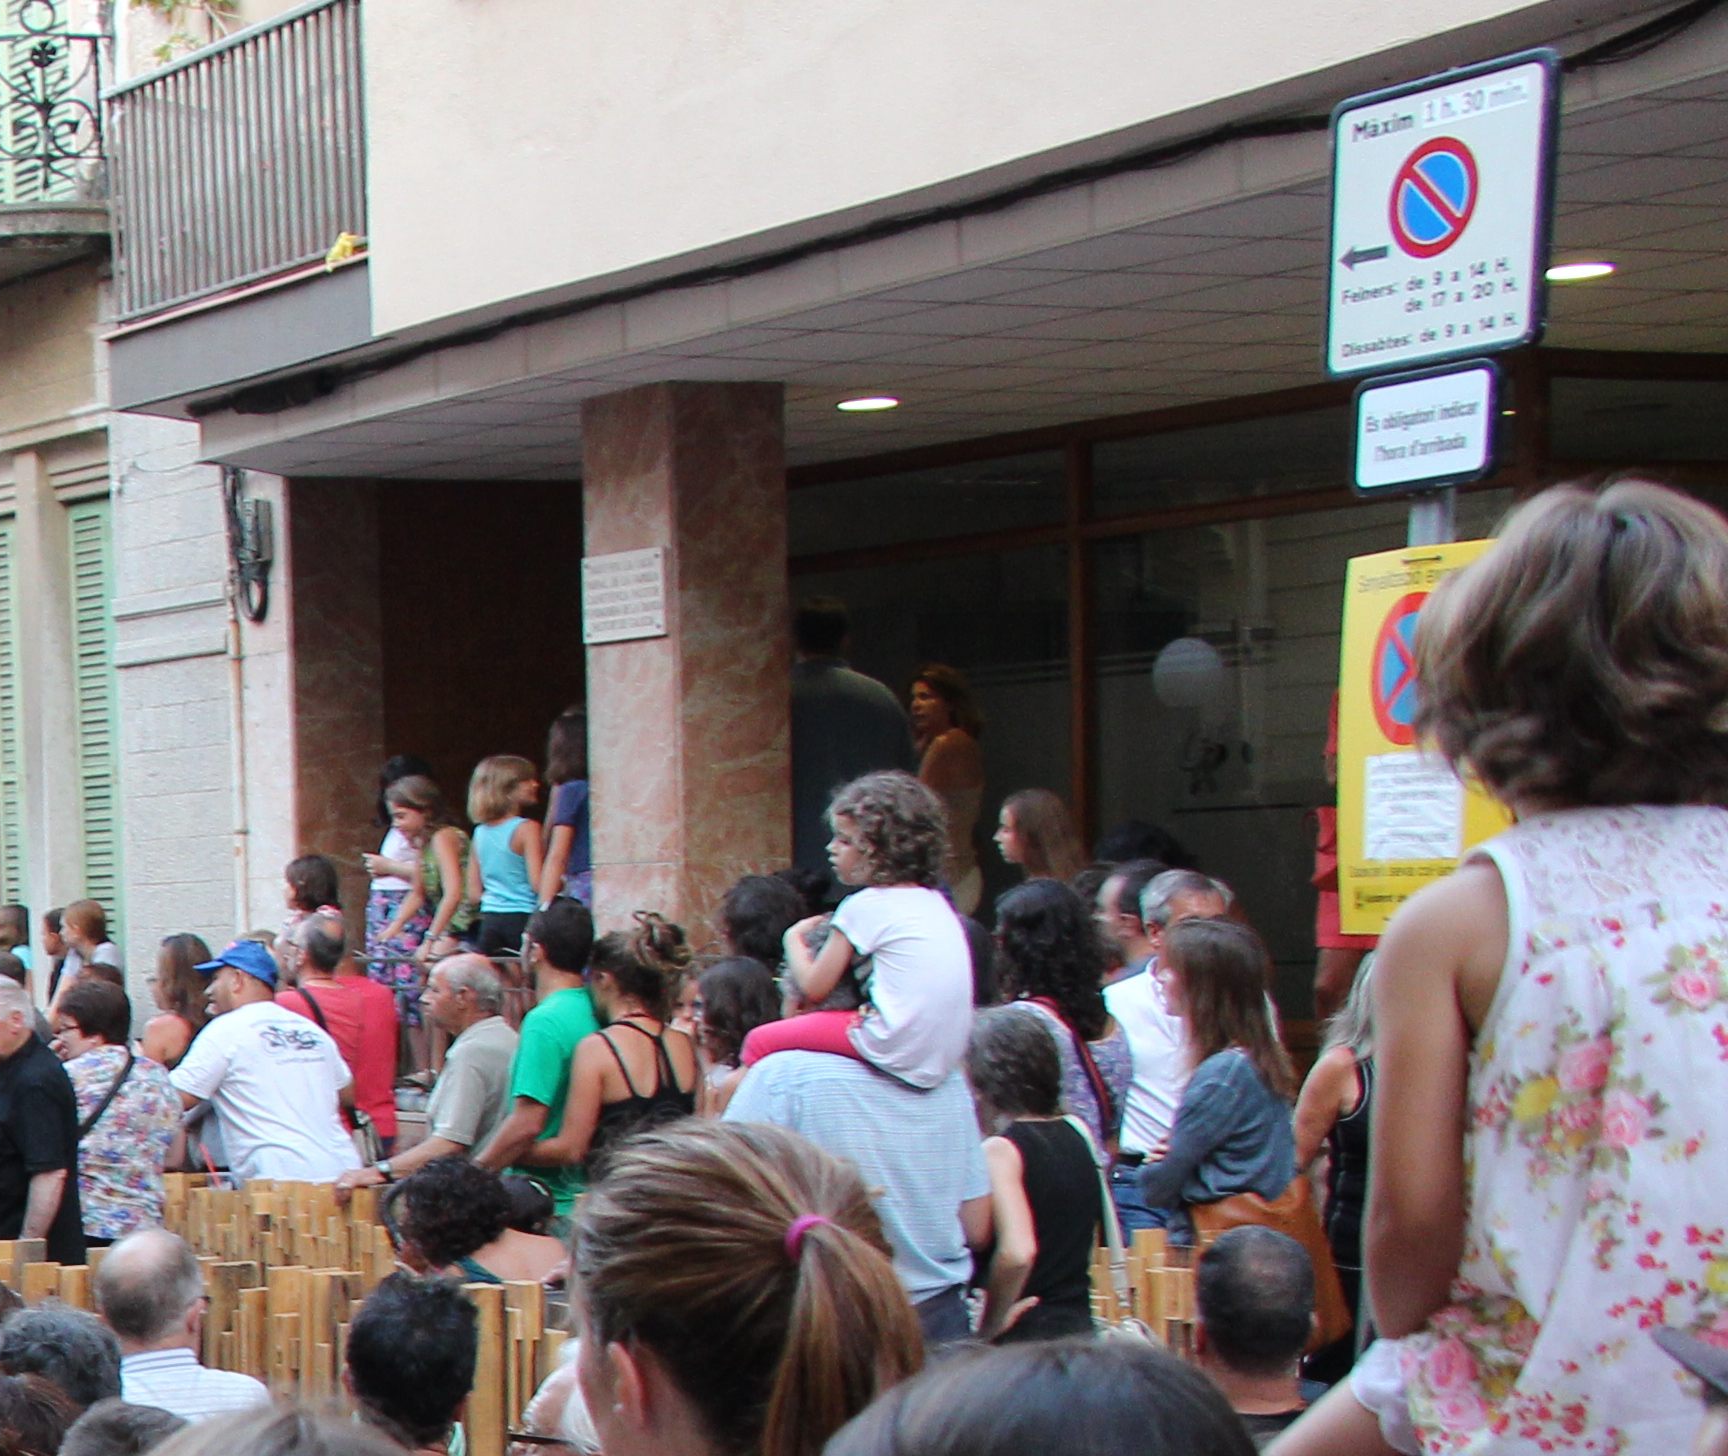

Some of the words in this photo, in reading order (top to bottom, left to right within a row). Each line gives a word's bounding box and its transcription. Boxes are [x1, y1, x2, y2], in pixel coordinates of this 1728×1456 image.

[1461, 89, 1488, 113] 30
[1406, 276, 1424, 292] de
[1432, 270, 1443, 286] 9
[1450, 271, 1461, 282] a
[1468, 260, 1487, 278] 14
[1404, 297, 1423, 313] de
[1431, 291, 1447, 307] 17
[1454, 291, 1465, 302] a
[1472, 281, 1495, 299] 20
[1419, 327, 1438, 343] de
[1445, 323, 1455, 338] 9
[1461, 323, 1472, 334] a
[1479, 315, 1495, 331] 14
